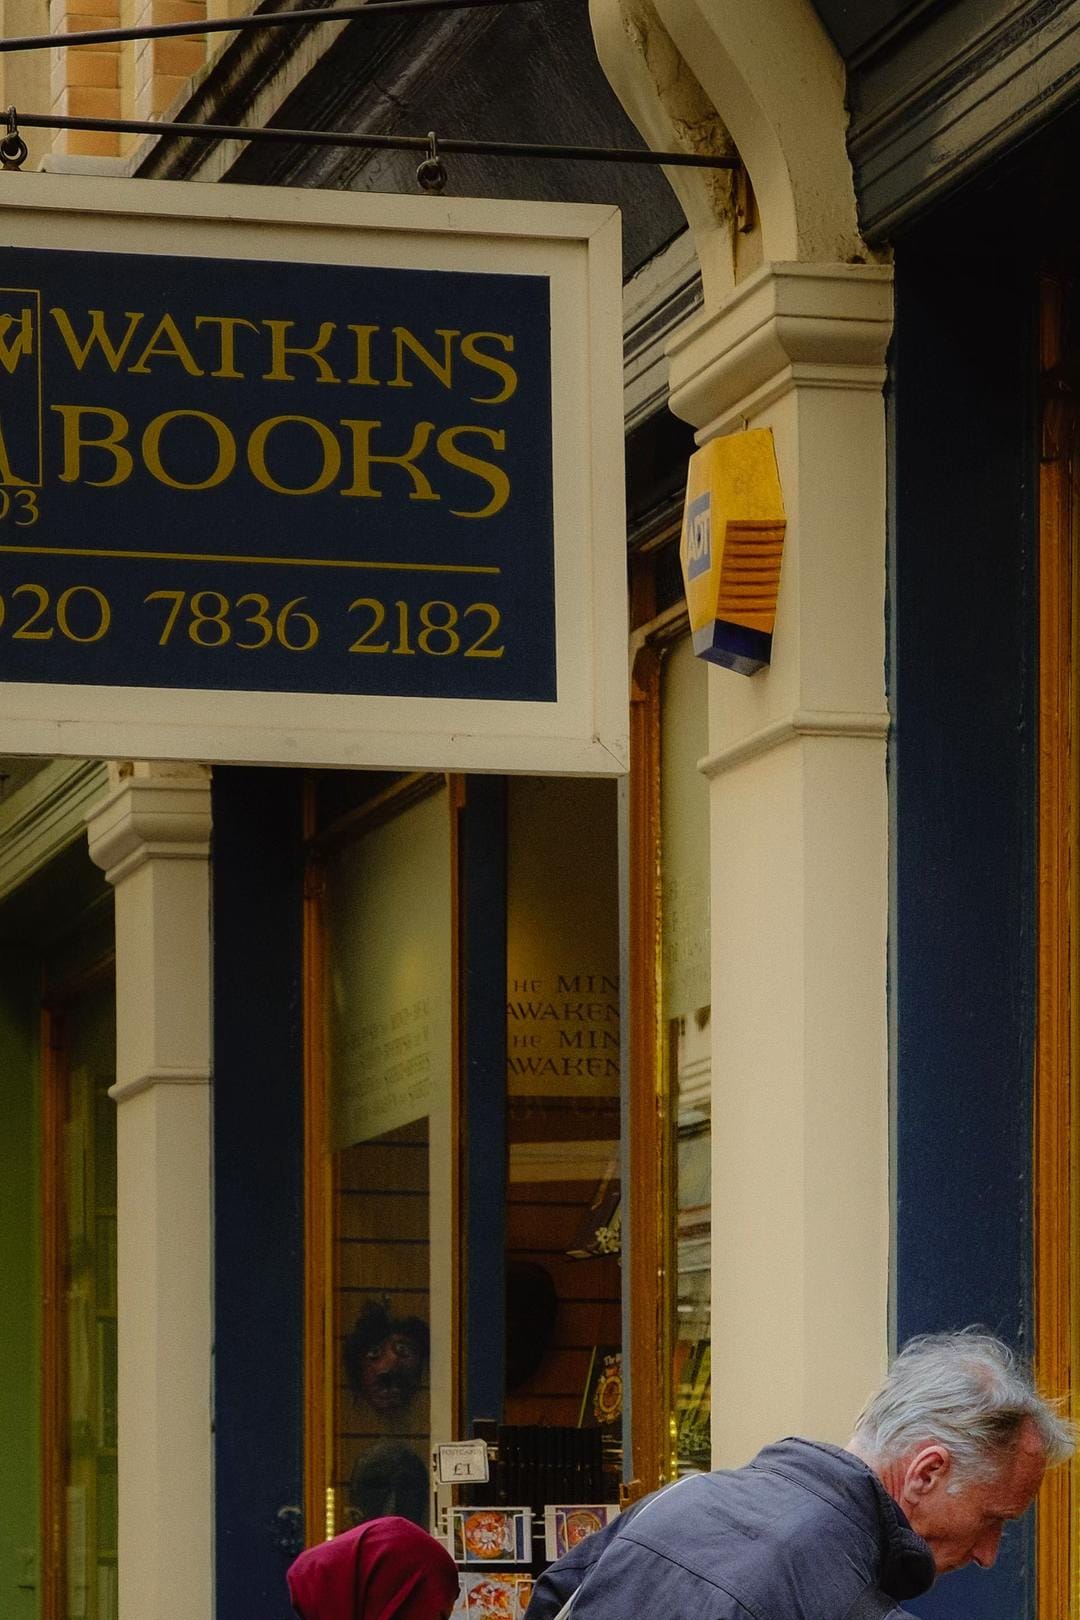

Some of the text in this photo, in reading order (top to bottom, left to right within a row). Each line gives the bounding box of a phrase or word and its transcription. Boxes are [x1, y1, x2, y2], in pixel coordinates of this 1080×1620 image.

[50, 307, 518, 404] WATKINS
[50, 404, 512, 519] BOOKS
[0, 583, 505, 659] 20 7836 2182
[453, 1463, 474, 1476] £1
